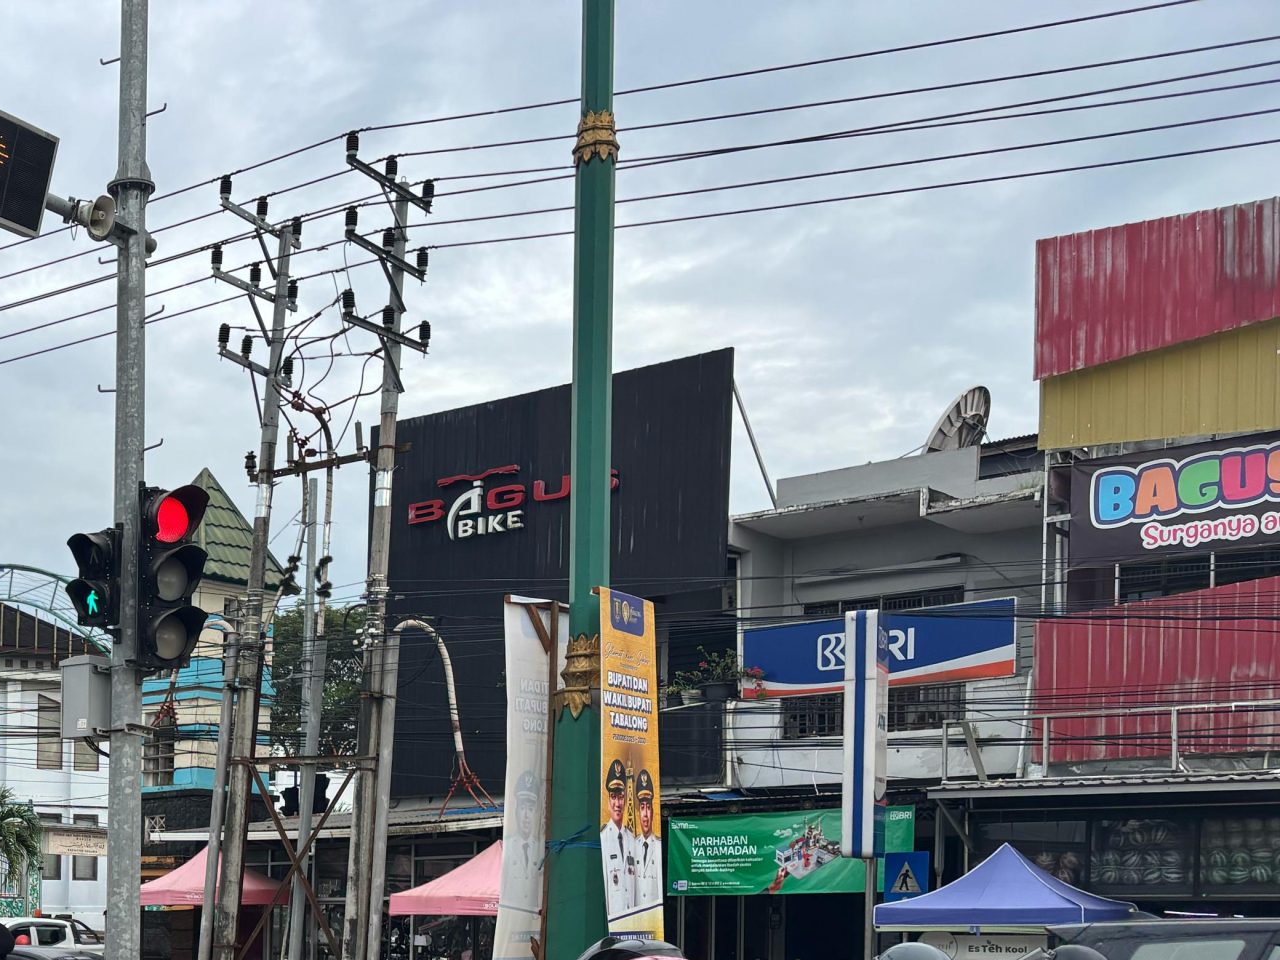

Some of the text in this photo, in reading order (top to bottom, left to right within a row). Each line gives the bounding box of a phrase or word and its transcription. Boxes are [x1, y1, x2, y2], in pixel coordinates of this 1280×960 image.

[1097, 451, 1280, 522] BAGU
[457, 510, 524, 539] BIKE
[1143, 516, 1256, 546] Surganya
[607, 671, 648, 693] BUPATI DAN
[603, 690, 652, 712] WAKIL BUPATI
[609, 711, 648, 731] TABALONG
[692, 835, 748, 847] MARHABAN
[692, 845, 757, 857] YA RAMADAN
[968, 944, 980, 954] Es
[1005, 945, 1027, 957] Kool
